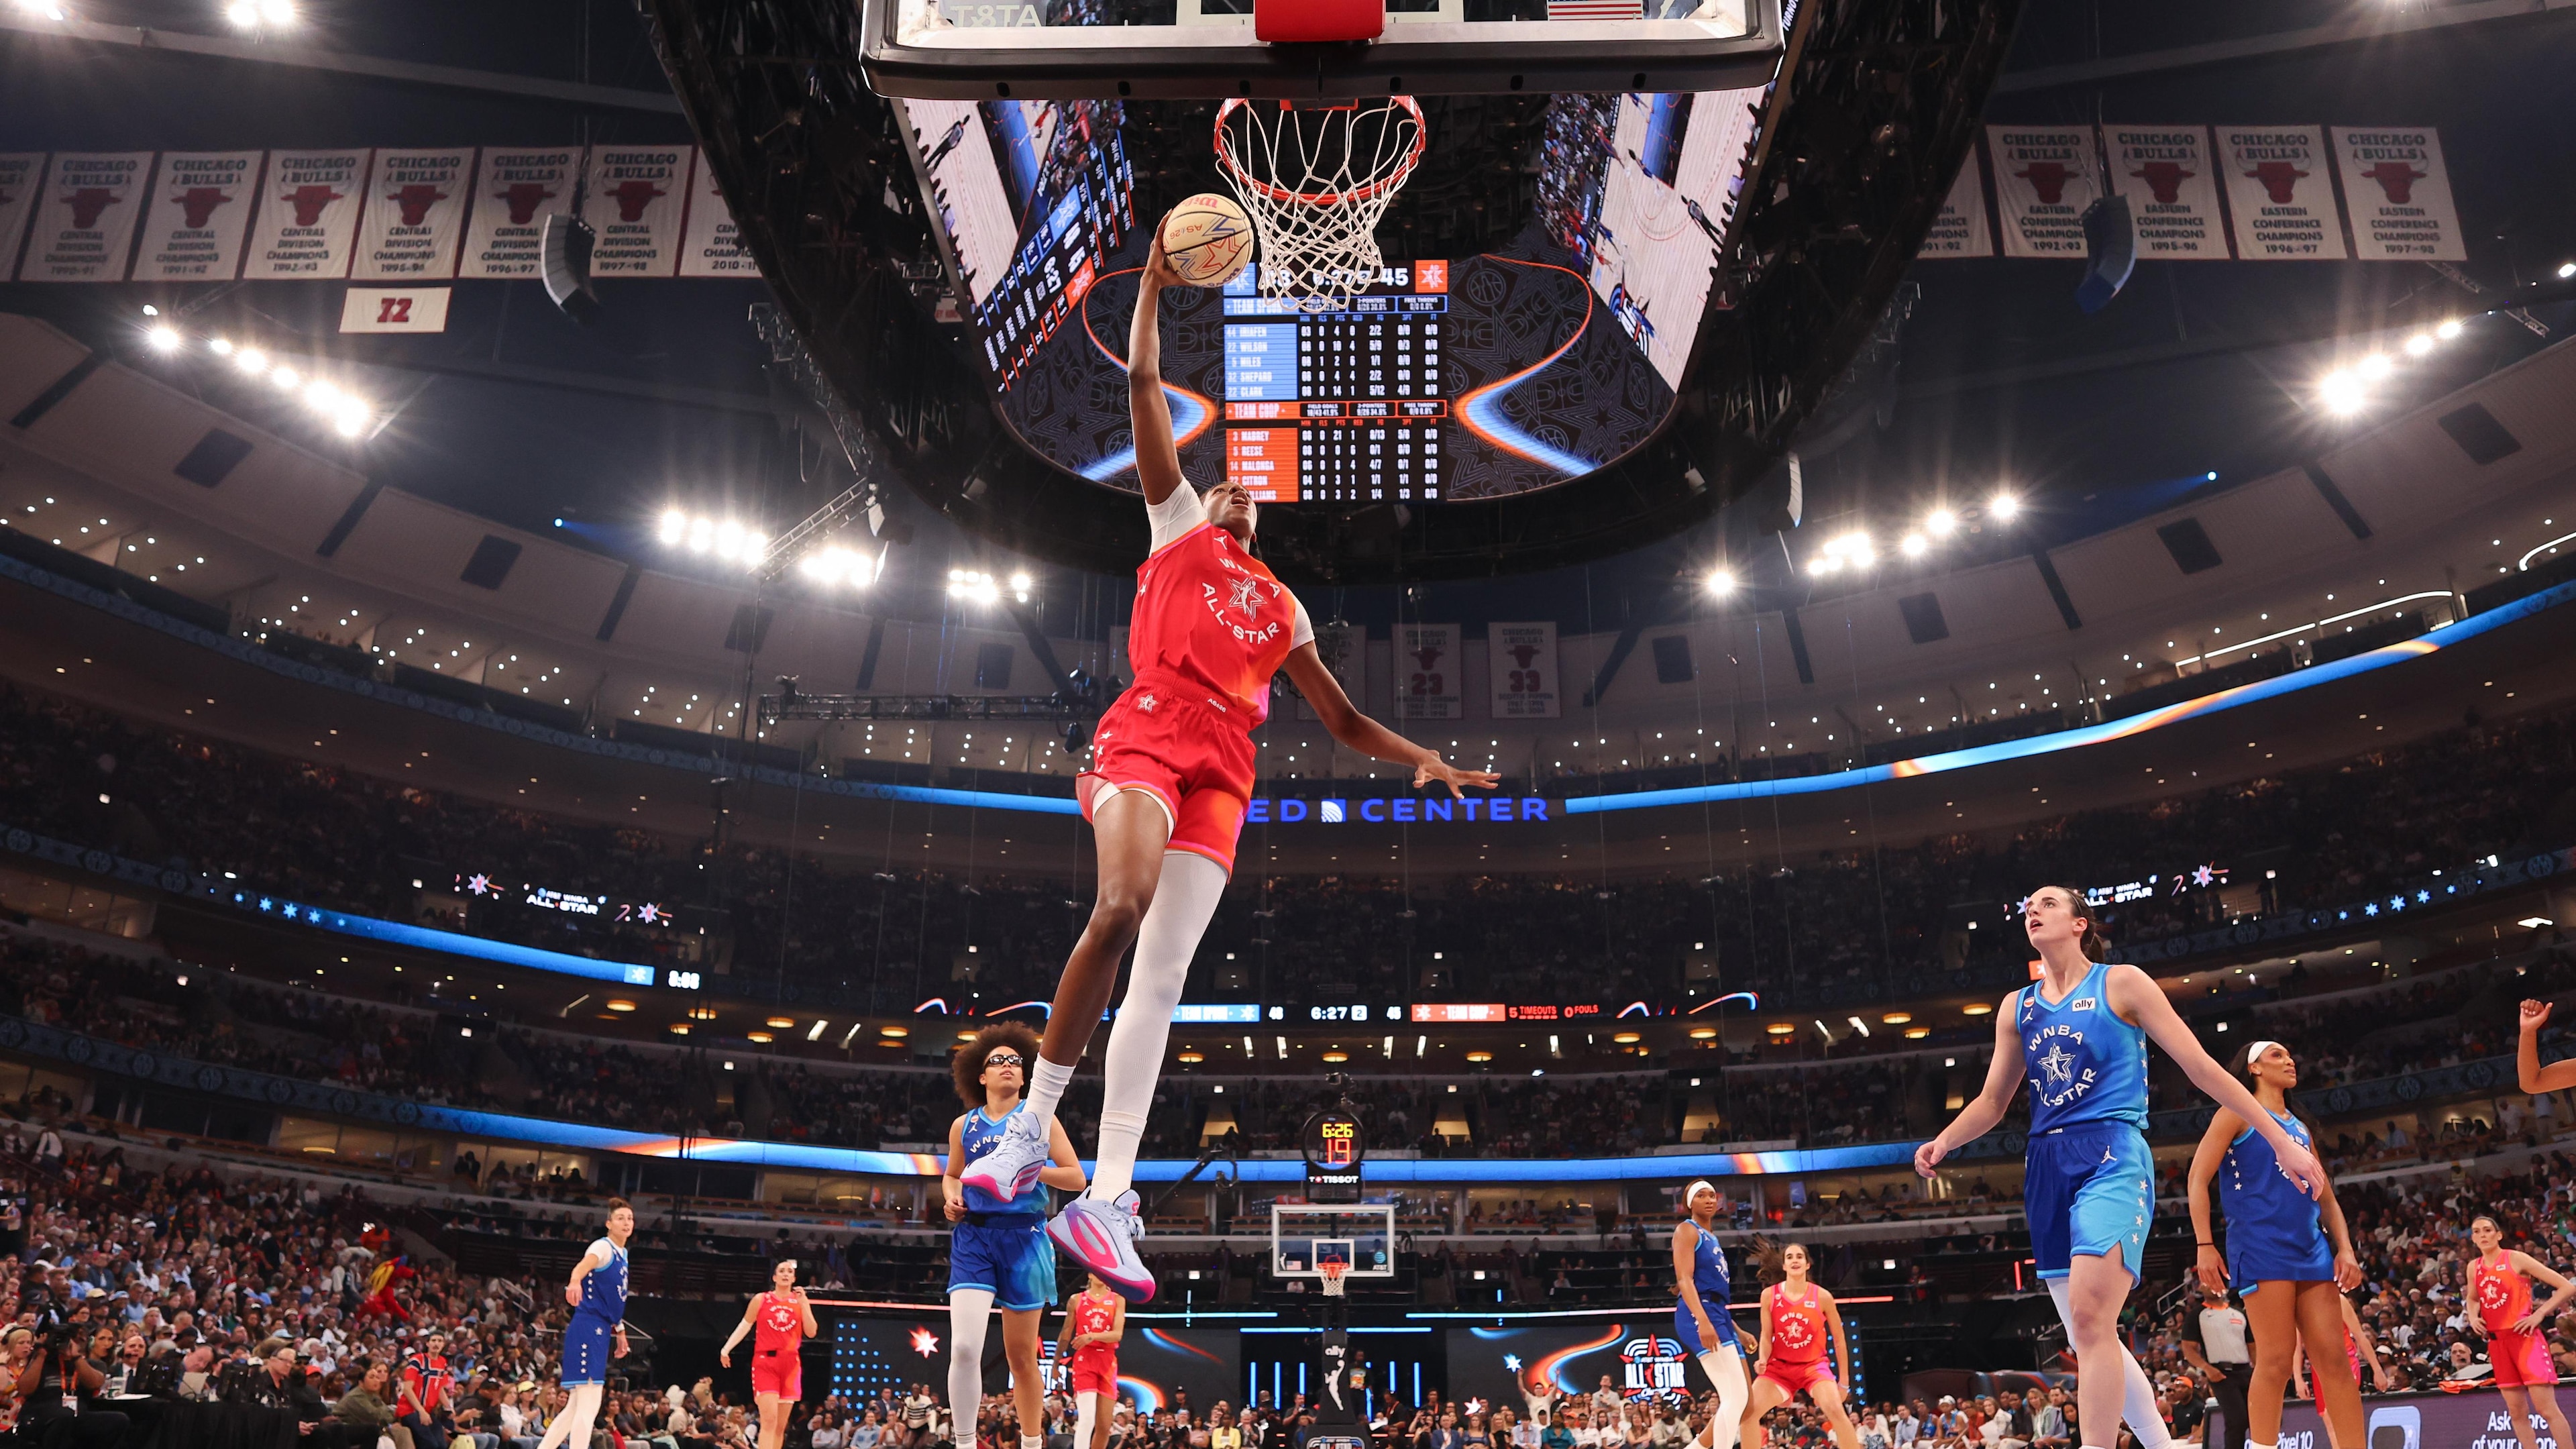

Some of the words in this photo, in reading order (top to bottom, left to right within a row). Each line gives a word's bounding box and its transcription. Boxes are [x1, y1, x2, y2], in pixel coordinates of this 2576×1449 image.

[2002, 134, 2080, 146] CHICAGO
[2118, 133, 2195, 146] CHICAGO
[2231, 133, 2308, 146] CHICAGO
[2348, 133, 2426, 146] CHICAGO
[604, 153, 678, 164] CHICAGO
[2018, 148, 2072, 160] BULLS
[2133, 148, 2187, 159] BULLS
[2247, 148, 2301, 160] BULLS
[2363, 148, 2418, 160] BULLS
[172, 160, 248, 171] CHICAGO
[281, 156, 357, 168] CHICAGO
[386, 156, 461, 168] CHICAGO
[494, 154, 569, 166] CHICAGO
[181, 173, 235, 184] BULLS
[291, 170, 343, 182] BULLS
[396, 170, 448, 182] BULLS
[504, 169, 555, 181] BULLS
[613, 167, 665, 178] BULLS
[2030, 205, 2075, 214] EASTERN
[2146, 205, 2191, 214] EASTERN
[2261, 207, 2308, 216] EASTERN
[2379, 207, 2425, 216] EASTERN
[2021, 217, 2083, 227] CONFERENC
[2137, 216, 2204, 226] CONFERENCE
[2253, 219, 2321, 229] CONFERENCE
[2371, 219, 2439, 229] CONFERENCE
[607, 225, 650, 233] CENTRAL
[2023, 229, 2083, 239] CHAMPION
[2139, 229, 2206, 239] CHAMPIONS
[604, 237, 650, 246] DIVISION
[2256, 231, 2323, 241] CHAMPIONS
[2373, 231, 2440, 241] CHAMPIONS
[385, 238, 431, 248] DIVISION
[491, 239, 539, 249] DIVISION
[594, 249, 657, 258] CHAMPIONS
[1380, 268, 1409, 286] 45
[377, 298, 413, 323] 72
[1232, 299, 1254, 314] TEAM
[1240, 341, 1268, 352] WILSON
[1240, 356, 1262, 367] MILES
[1240, 371, 1273, 382] SHEPARD
[1240, 386, 1263, 397] CLARK
[1333, 385, 1342, 396] 14
[1234, 403, 1256, 419] TEAM
[1241, 431, 1270, 441] MABREY
[1333, 430, 1342, 441] 21
[1241, 445, 1264, 457] REESE
[1230, 460, 1238, 471] 14
[1242, 460, 1275, 471] MALONGA
[1201, 582, 1281, 644] ALL-STAR
[1411, 673, 1442, 695] 23
[1509, 670, 1540, 692] 33
[1360, 798, 1548, 822] CENTER
[2116, 881, 2141, 893] WNBA
[563, 894, 589, 904] WNBA
[2075, 998, 2093, 1010] ally
[1181, 1006, 1201, 1020] TEAM
[1311, 1006, 1347, 1020] 6:27
[1356, 1009, 1363, 1017] 2
[1387, 1006, 1401, 1020] 45
[1446, 1005, 1467, 1020] TEAM
[1509, 1007, 1518, 1018] 5
[1519, 1006, 1557, 1015] TIMEOUTS
[1564, 1007, 1574, 1018] 0
[1574, 1004, 1599, 1014] FOULS
[2028, 1024, 2084, 1052] WNBA
[2030, 1067, 2097, 1108] ALL-STAR
[1322, 1123, 1353, 1138] 6:26
[970, 1134, 1002, 1153] WNB
[1326, 1138, 1351, 1165] 19
[1322, 1175, 1359, 1184] TISSOT
[1779, 1311, 1809, 1325] WNBA
[1777, 1332, 1813, 1350] ALL-STAR
[1324, 1345, 1346, 1358] ally
[1625, 1363, 1648, 1389] ALL
[1654, 1362, 1686, 1388] STAR
[2487, 1411, 2512, 1432] Ask
[2528, 1413, 2548, 1430] ore
[2300, 1430, 2314, 1449] 10
[2472, 1434, 2486, 1449] of
